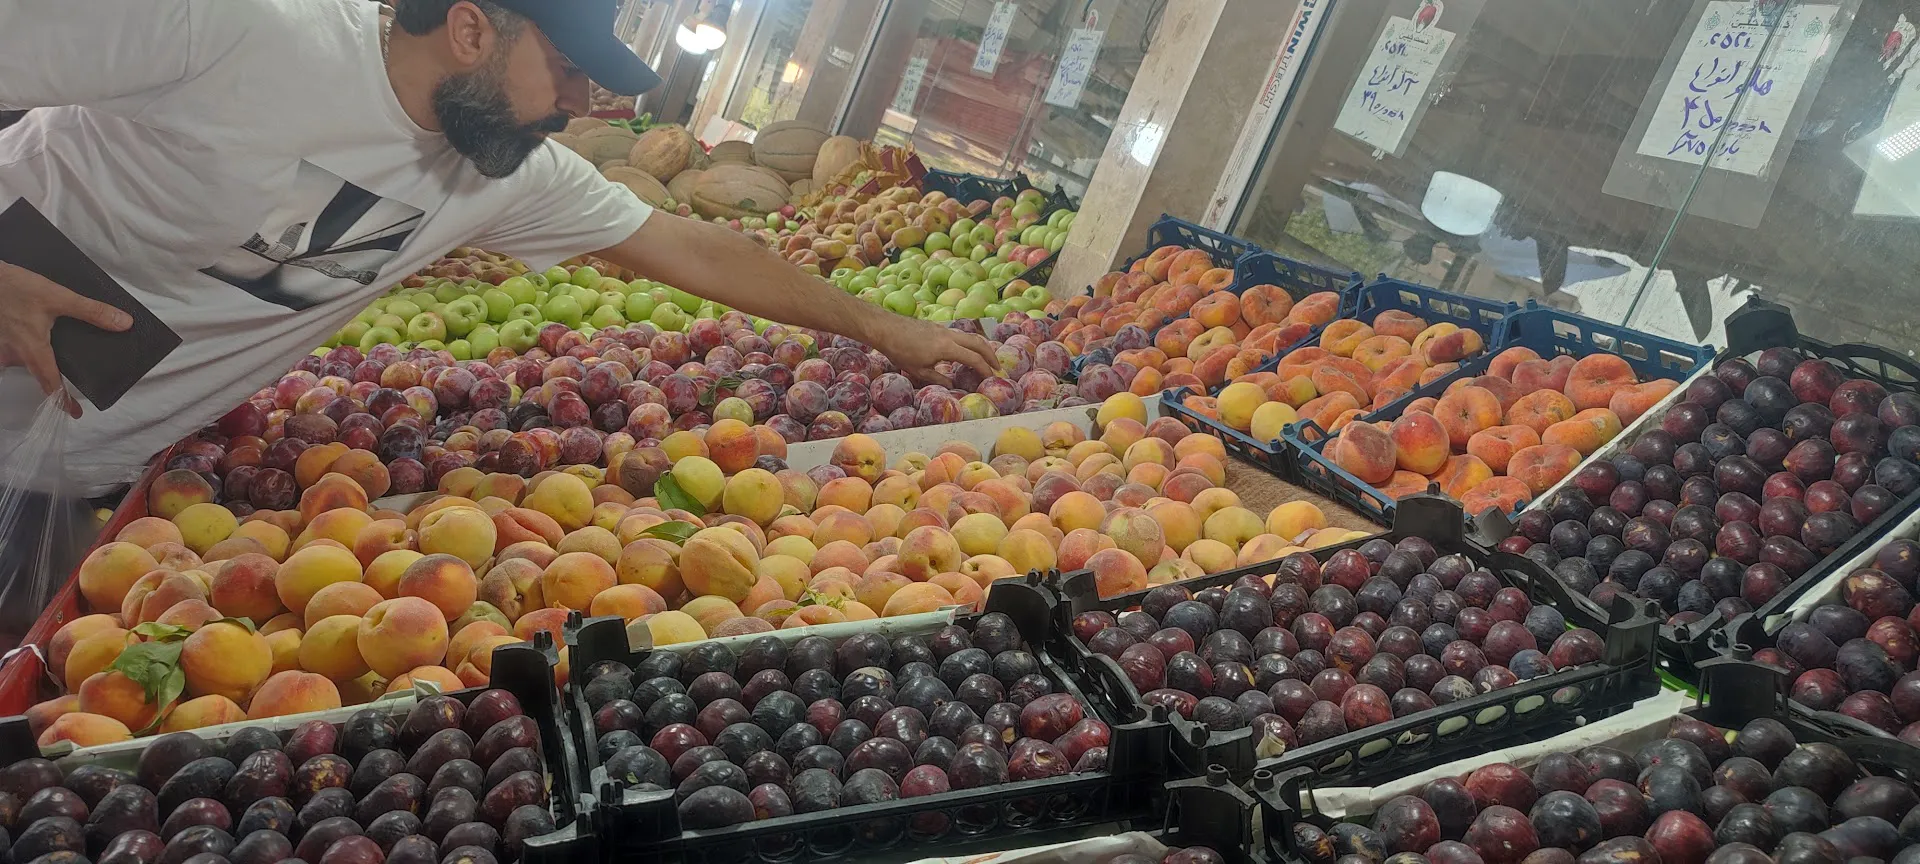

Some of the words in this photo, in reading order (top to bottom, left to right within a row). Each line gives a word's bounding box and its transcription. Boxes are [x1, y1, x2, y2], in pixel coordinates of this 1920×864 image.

[1263, 10, 1312, 110] WINTECH
[1368, 64, 1397, 86] انواع
[1689, 57, 1739, 93] انواع
[1387, 74, 1419, 95] آلو
[1724, 66, 1773, 99] هلو
